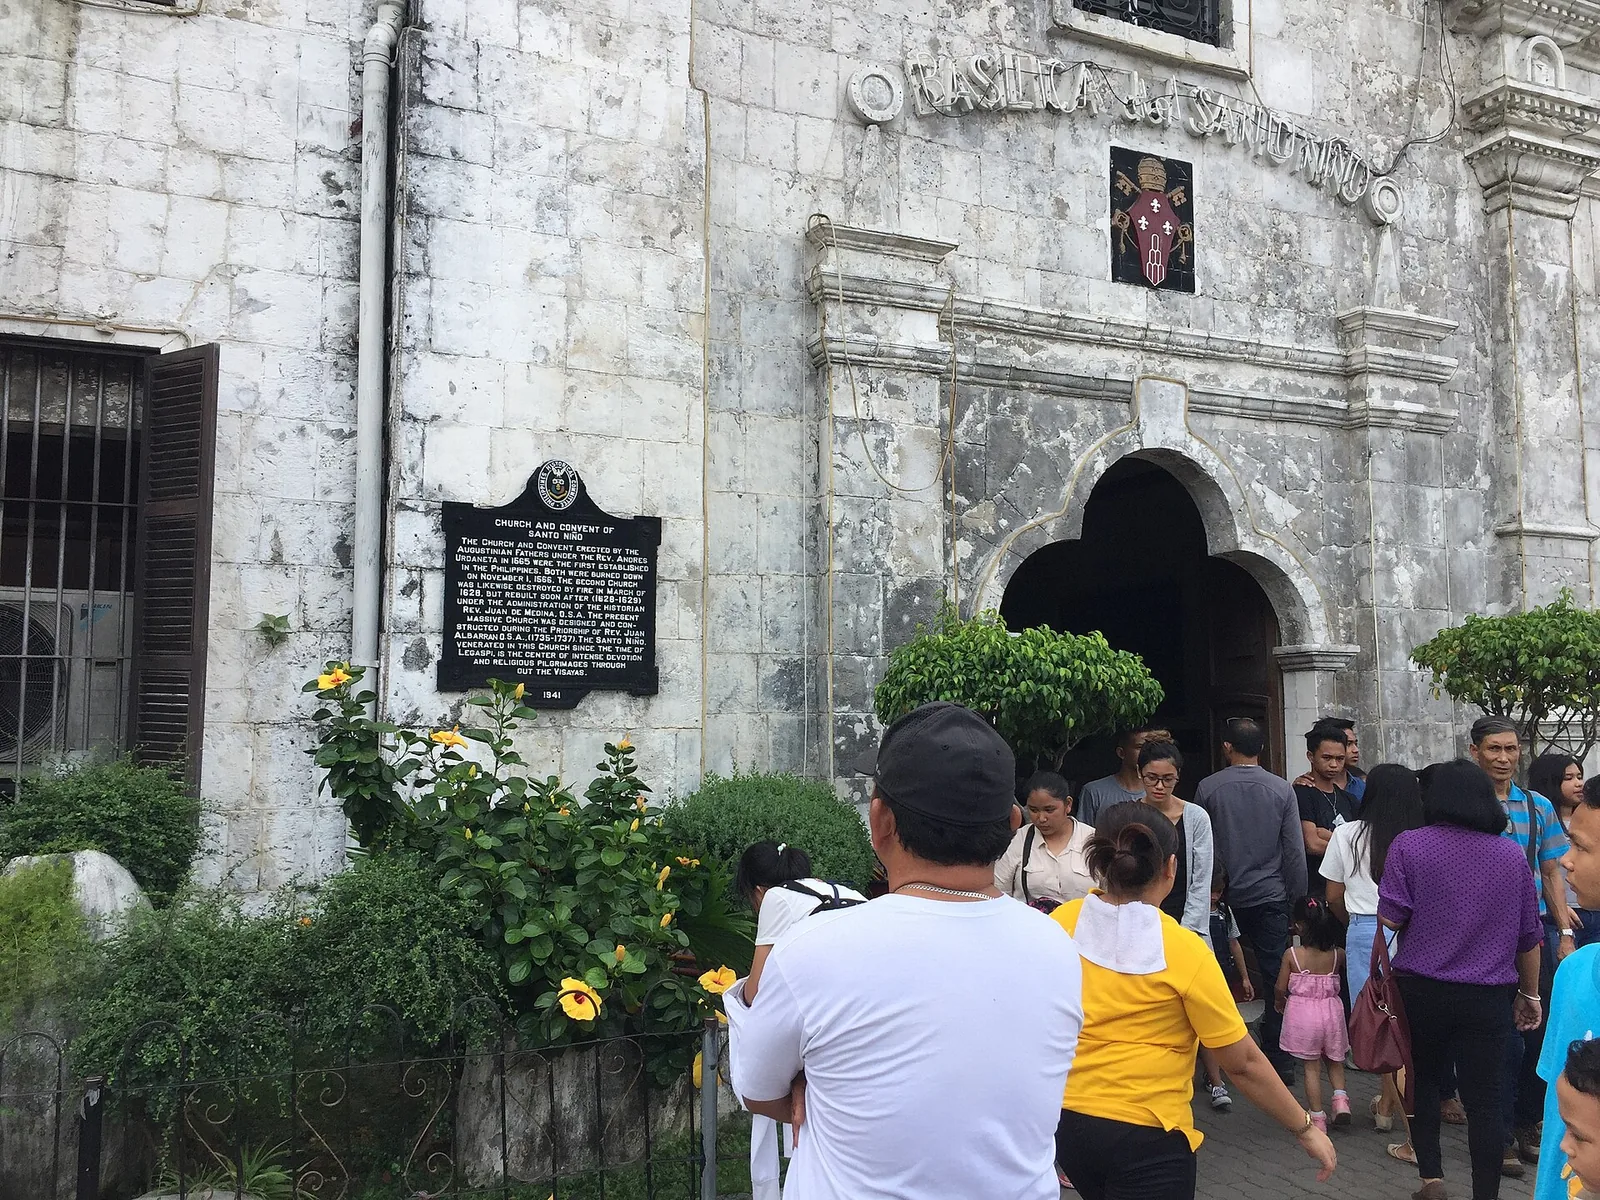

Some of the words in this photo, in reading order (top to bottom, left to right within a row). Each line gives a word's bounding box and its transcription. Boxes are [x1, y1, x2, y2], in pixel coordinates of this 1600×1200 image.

[904, 52, 1103, 115] BASILICA
[1124, 70, 1181, 125] del
[1183, 86, 1295, 166] SANTO
[494, 518, 531, 528] CHURCH
[535, 521, 555, 530] AND
[559, 523, 600, 533] CONVENT
[528, 530, 559, 539] SANTO
[563, 530, 583, 540] NIÑO
[461, 536, 478, 545] THE
[481, 538, 514, 547] CHURCH
[536, 542, 573, 551] CONVENT
[576, 545, 610, 553] ERECTED
[456, 545, 512, 555] AUGUSTINIAN
[515, 548, 549, 558] FATHERS
[595, 553, 614, 561] REV.
[616, 555, 647, 563] ANDRES
[455, 553, 498, 563] URDANETA
[573, 561, 595, 569] FIRST
[598, 563, 649, 571] ESTABLISHED
[472, 564, 488, 572] THE
[490, 564, 541, 574] PHILIPPINES.
[544, 567, 565, 575] BOTH
[622, 572, 643, 580] DOWN
[480, 572, 523, 581] NOVEMBER
[556, 576, 573, 584] THE
[575, 578, 605, 586] SECOND
[607, 579, 638, 587] CHURCH
[476, 582, 513, 590] LIKEWISE
[515, 583, 561, 592] DESTROYED
[595, 587, 603, 595] IN
[606, 587, 633, 596] MARCH
[504, 591, 537, 599] REBUILT
[591, 594, 641, 604] (1628-1629)
[487, 598, 503, 606] THE
[506, 600, 571, 609] ADMINISTRATION
[603, 604, 645, 612] HISTORIAN
[462, 605, 481, 613] REV.
[484, 607, 507, 615] JUAN
[558, 610, 585, 618] O.S.A.
[587, 611, 603, 619] THE
[604, 613, 639, 621] PRESENT
[466, 615, 502, 623] MASSIVE
[505, 615, 538, 624] CHURCH
[558, 618, 596, 626] DESIGNED
[453, 631, 498, 640] ALBARRAN
[595, 636, 622, 644] SANTO
[456, 623, 499, 631] STRUCTED
[501, 625, 530, 633] DURING
[532, 626, 547, 634] THE
[549, 626, 590, 635] PRIORSHIP
[604, 628, 621, 636] REV.
[623, 629, 644, 638] JUAN
[456, 641, 504, 649] VENERATED
[538, 642, 570, 650] CHURCH
[492, 658, 534, 666] RELIGIOUS
[536, 659, 588, 669] PILGRIMAGES
[606, 653, 642, 661] DEVOTION
[553, 667, 587, 675] VISAYAS.
[543, 691, 561, 699] 1941
